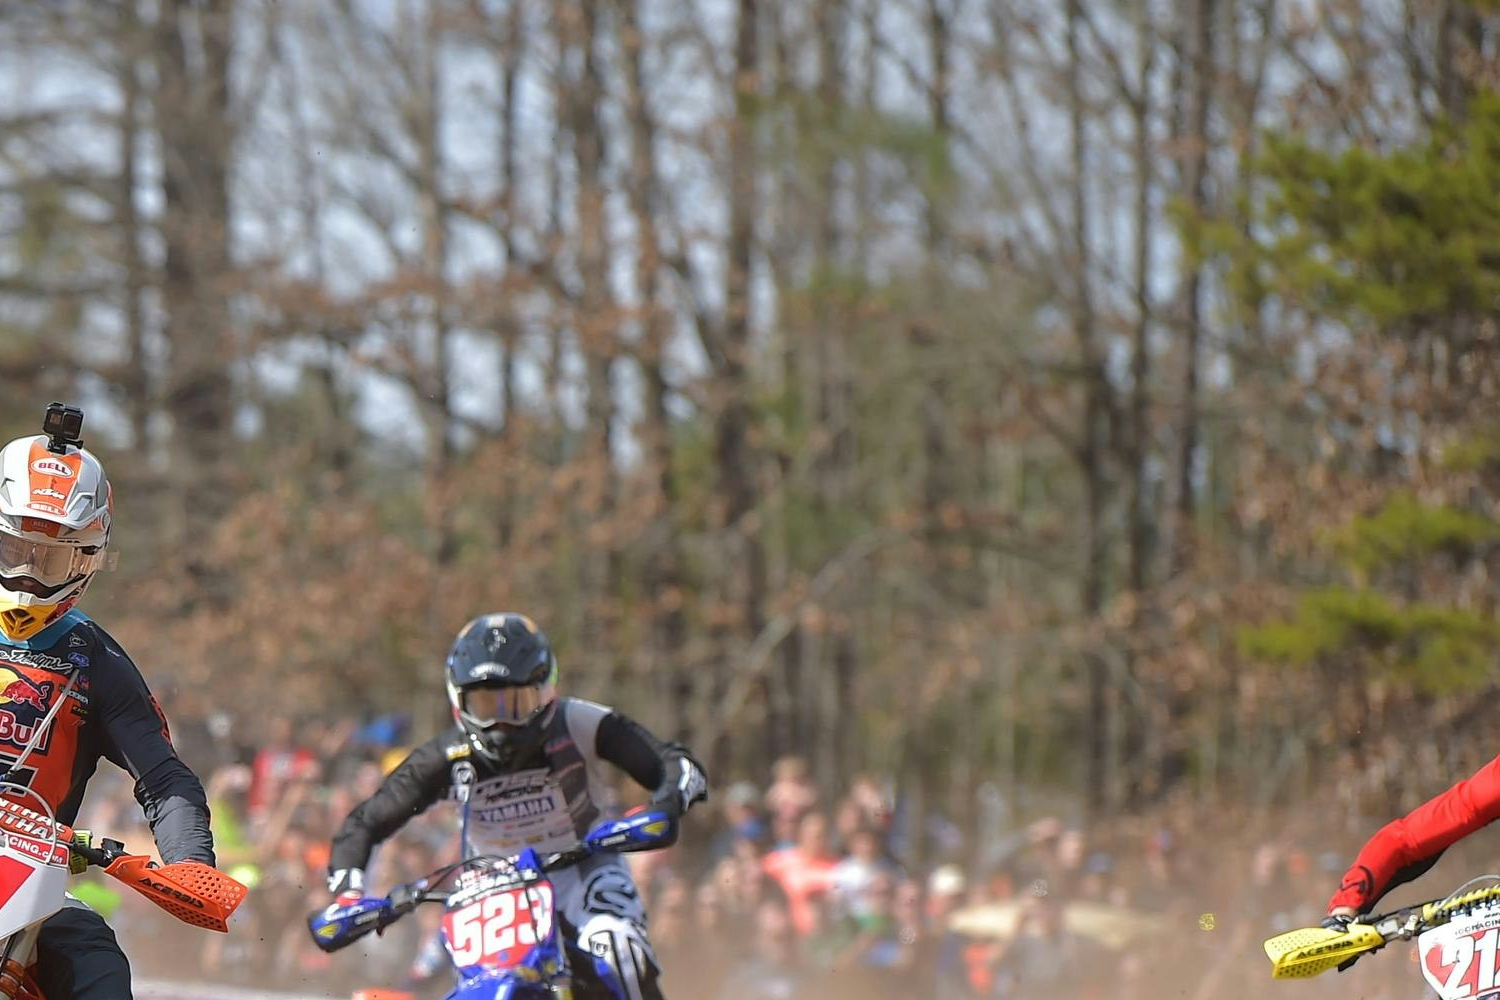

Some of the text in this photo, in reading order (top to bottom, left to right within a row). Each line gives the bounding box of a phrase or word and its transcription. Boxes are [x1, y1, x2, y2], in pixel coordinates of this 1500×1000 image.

[38, 462, 68, 475] BELL
[31, 503, 62, 515] BELL
[139, 877, 205, 908] ACERBIS
[451, 885, 552, 967] 523
[1297, 940, 1354, 959] ACERBIS
